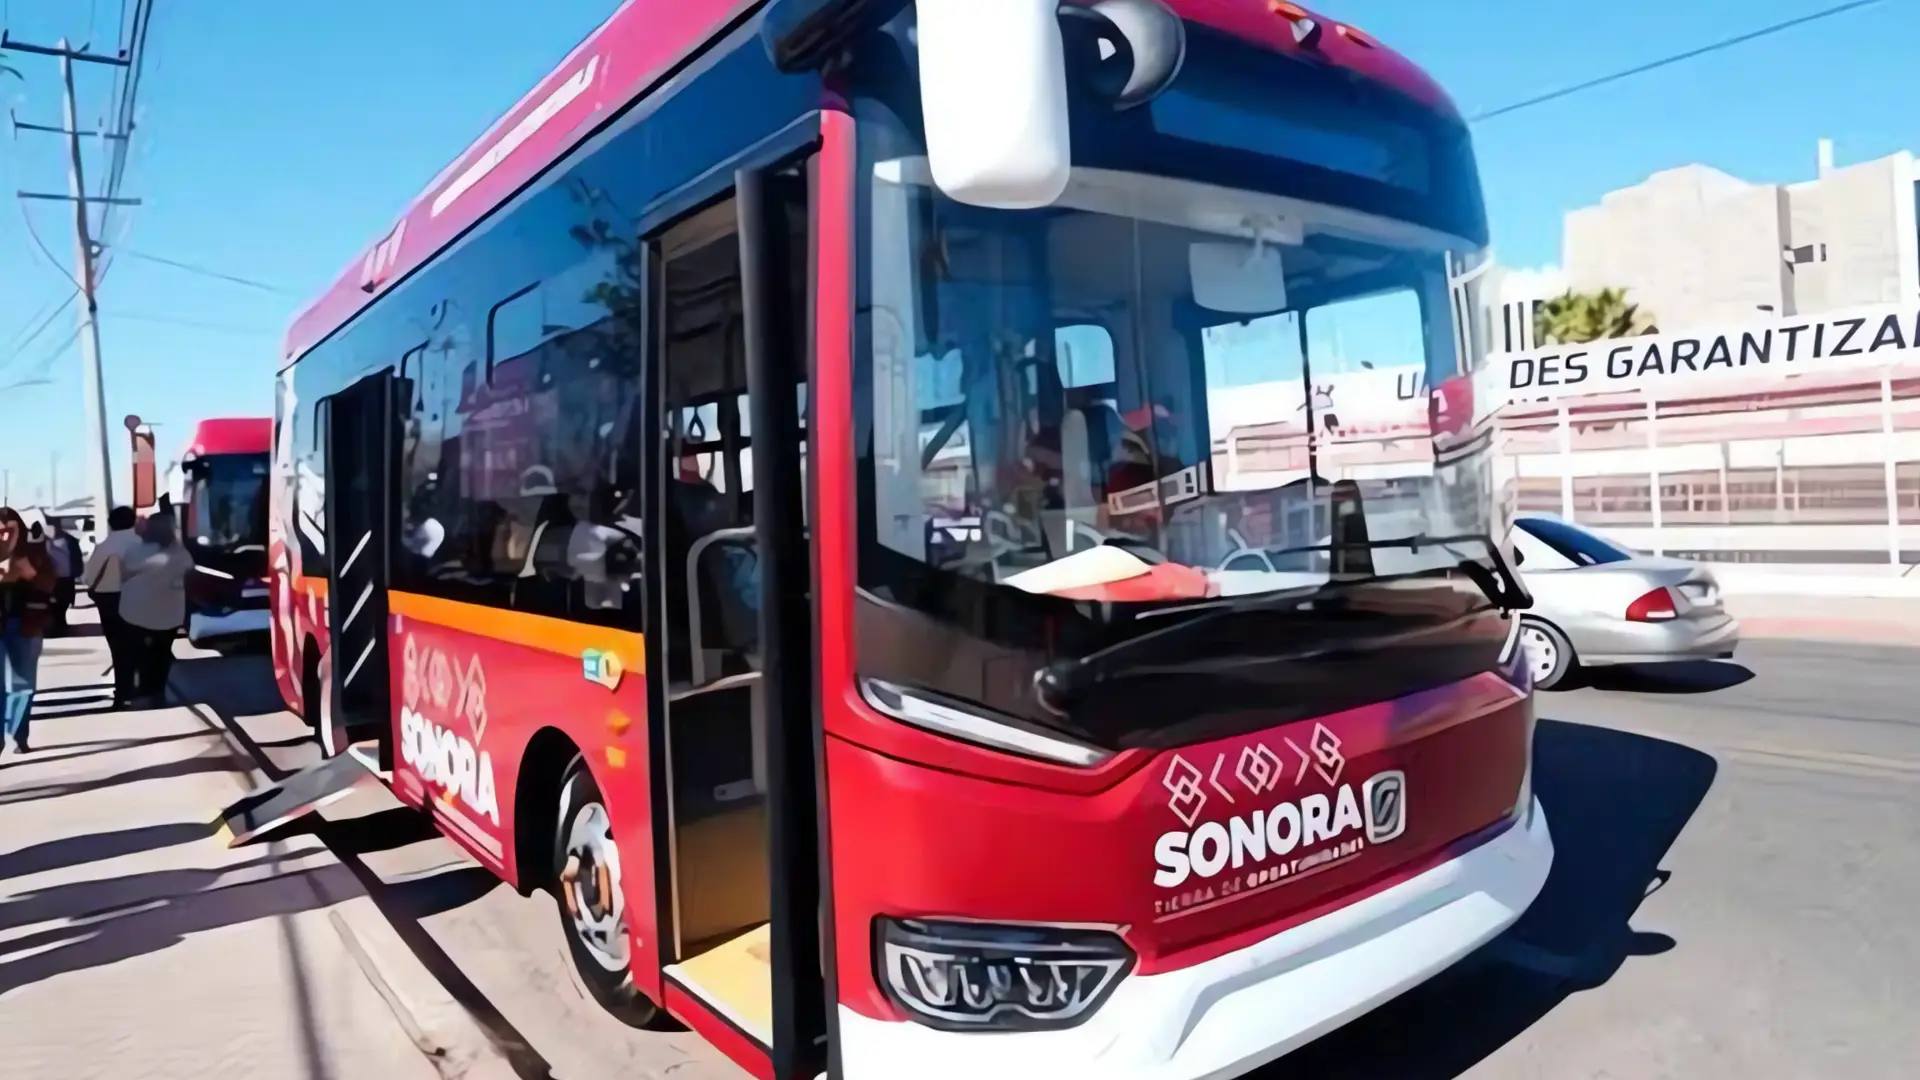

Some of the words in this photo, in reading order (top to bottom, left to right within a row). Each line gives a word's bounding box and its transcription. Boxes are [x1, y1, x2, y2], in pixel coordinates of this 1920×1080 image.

[1607, 309, 1920, 379] GARANTIZA
[401, 706, 499, 828] SONORA
[1153, 783, 1363, 888] SONORA
